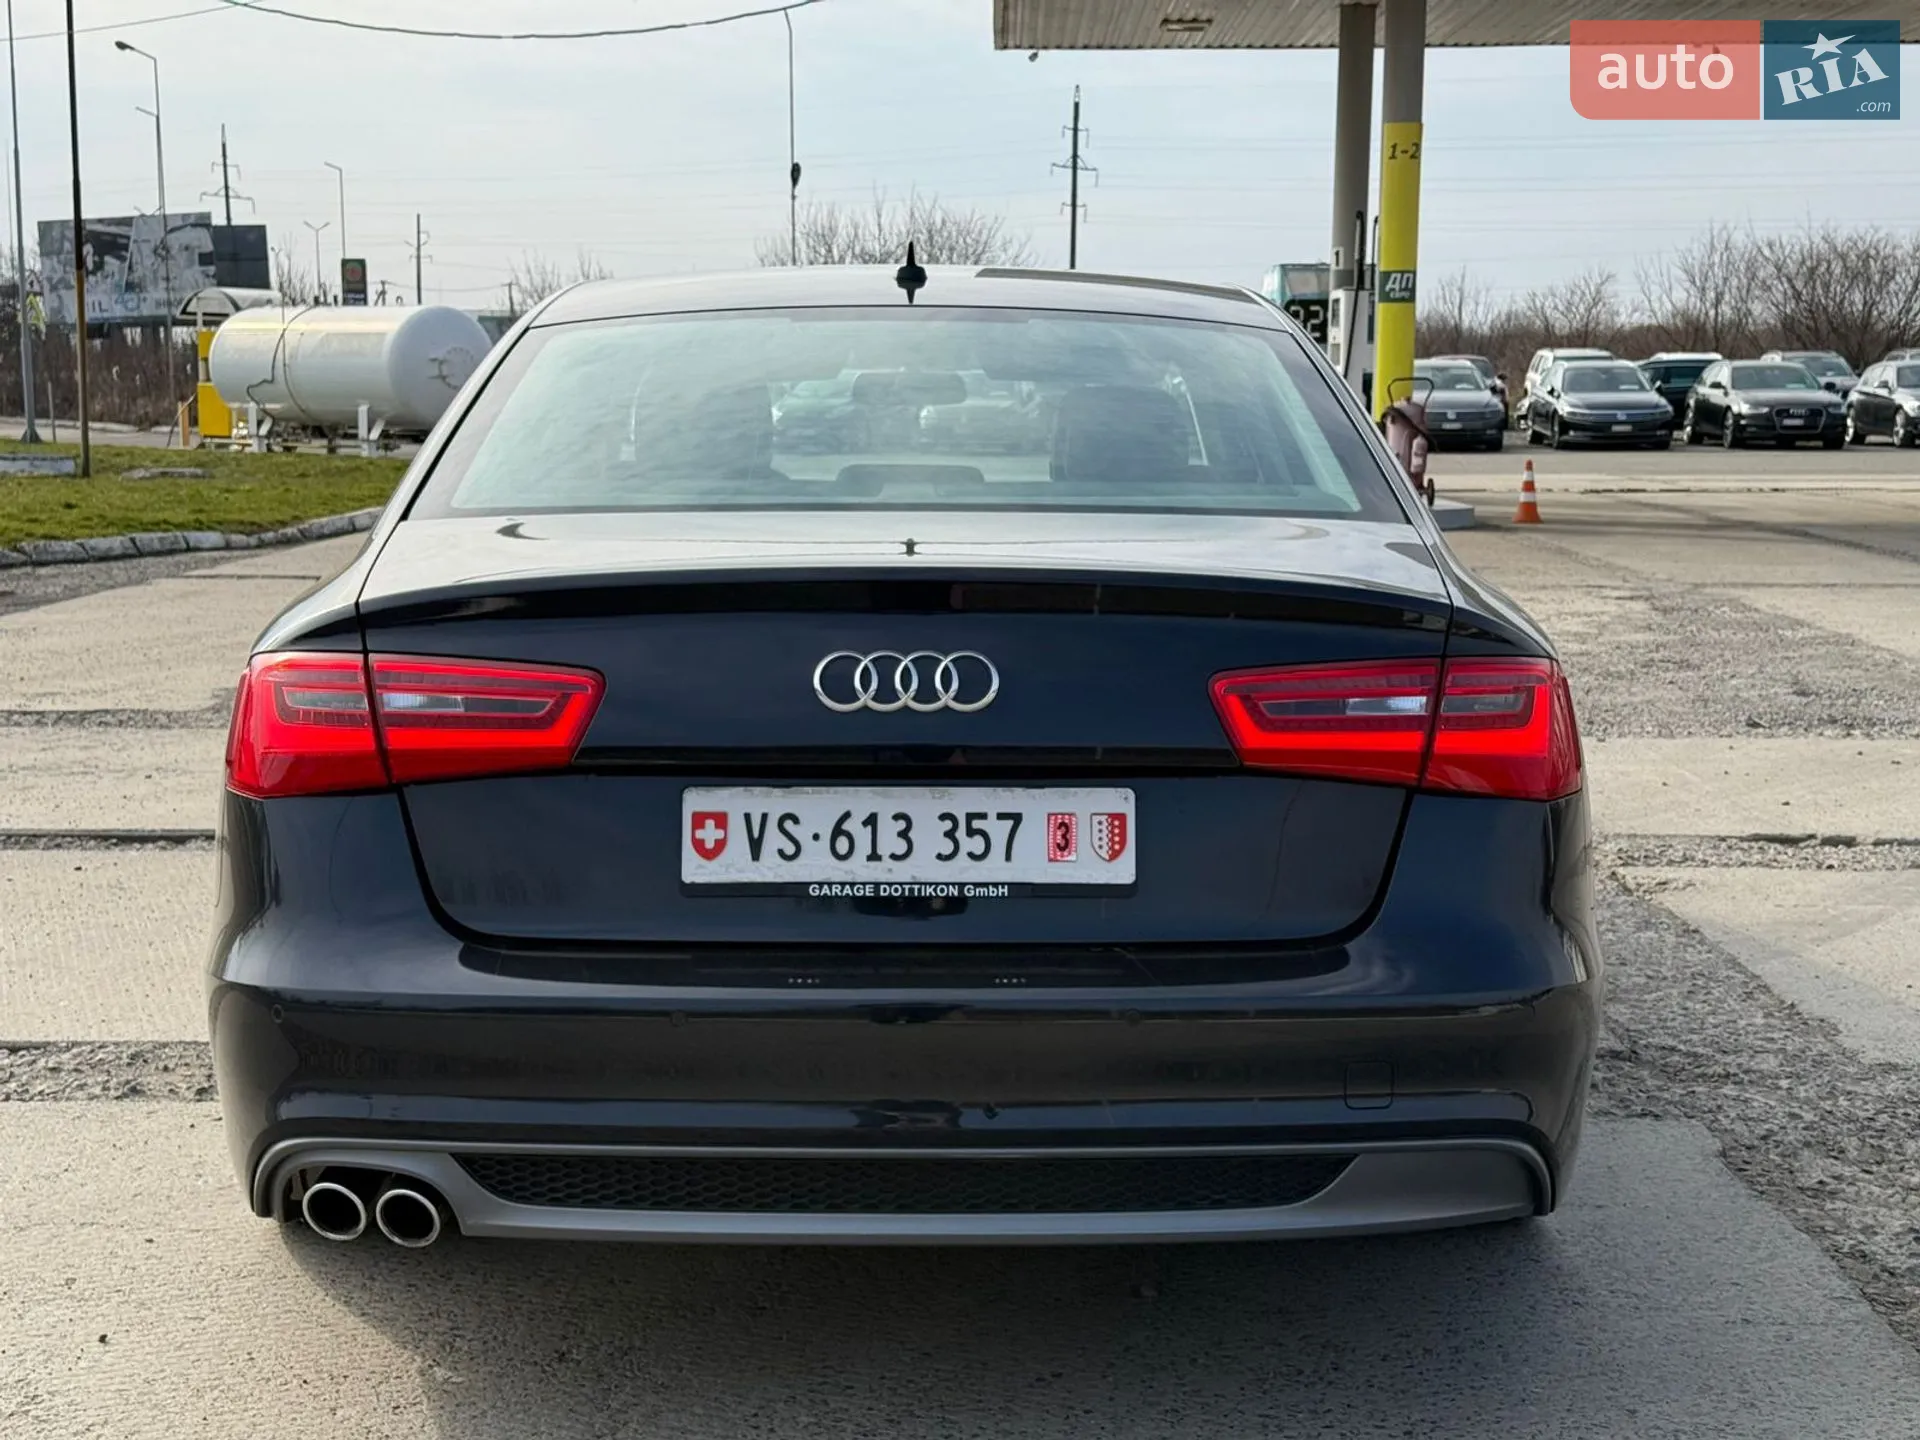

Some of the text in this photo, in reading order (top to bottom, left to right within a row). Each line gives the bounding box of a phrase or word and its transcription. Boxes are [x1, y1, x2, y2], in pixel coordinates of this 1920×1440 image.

[1388, 142, 1420, 160] 1-2
[935, 811, 1024, 863] 357
[1056, 821, 1070, 852] 3
[808, 884, 1009, 897] GARAGE DOTTIKON GmbH
